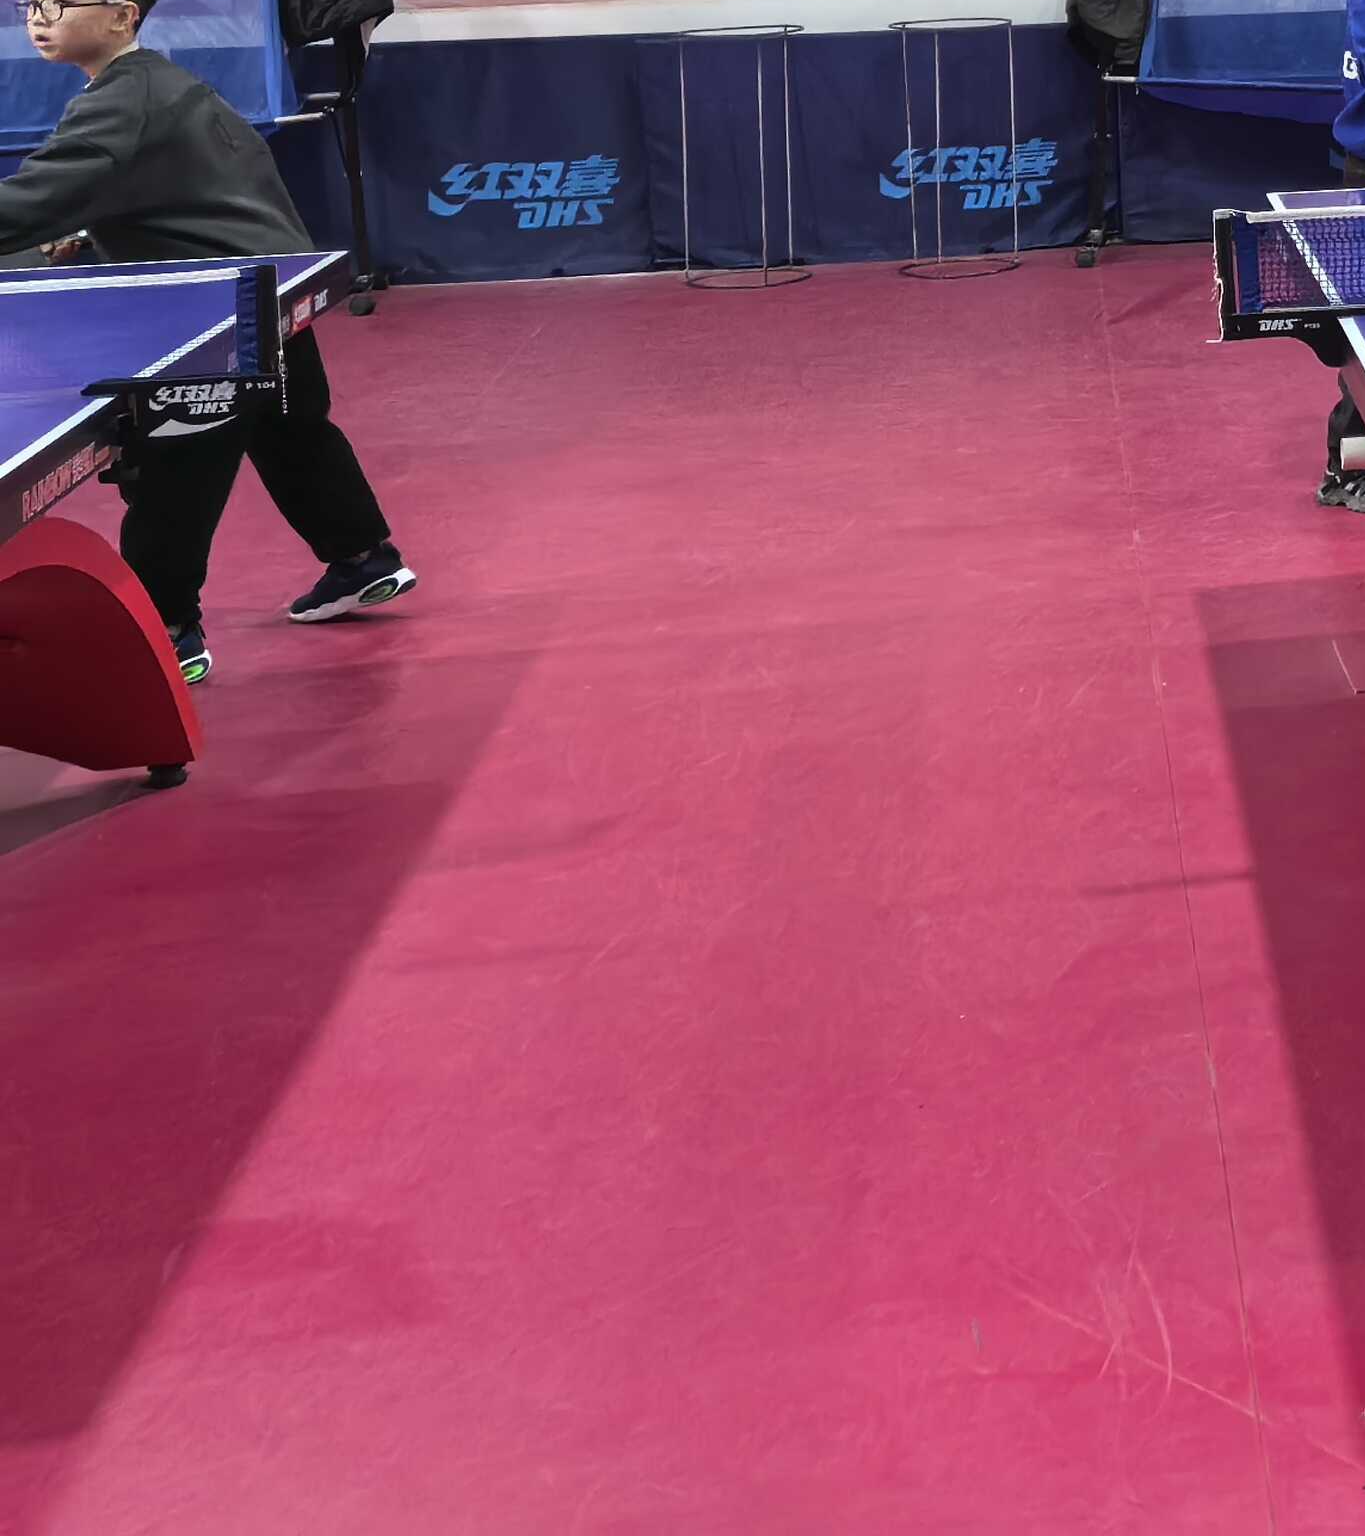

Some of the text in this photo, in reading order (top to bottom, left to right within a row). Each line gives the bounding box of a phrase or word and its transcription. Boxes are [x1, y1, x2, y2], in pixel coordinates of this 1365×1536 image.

[432, 154, 622, 206] 红双喜
[882, 137, 1059, 187] 红双喜
[513, 198, 615, 230] DHS
[957, 179, 1053, 211] DHS
